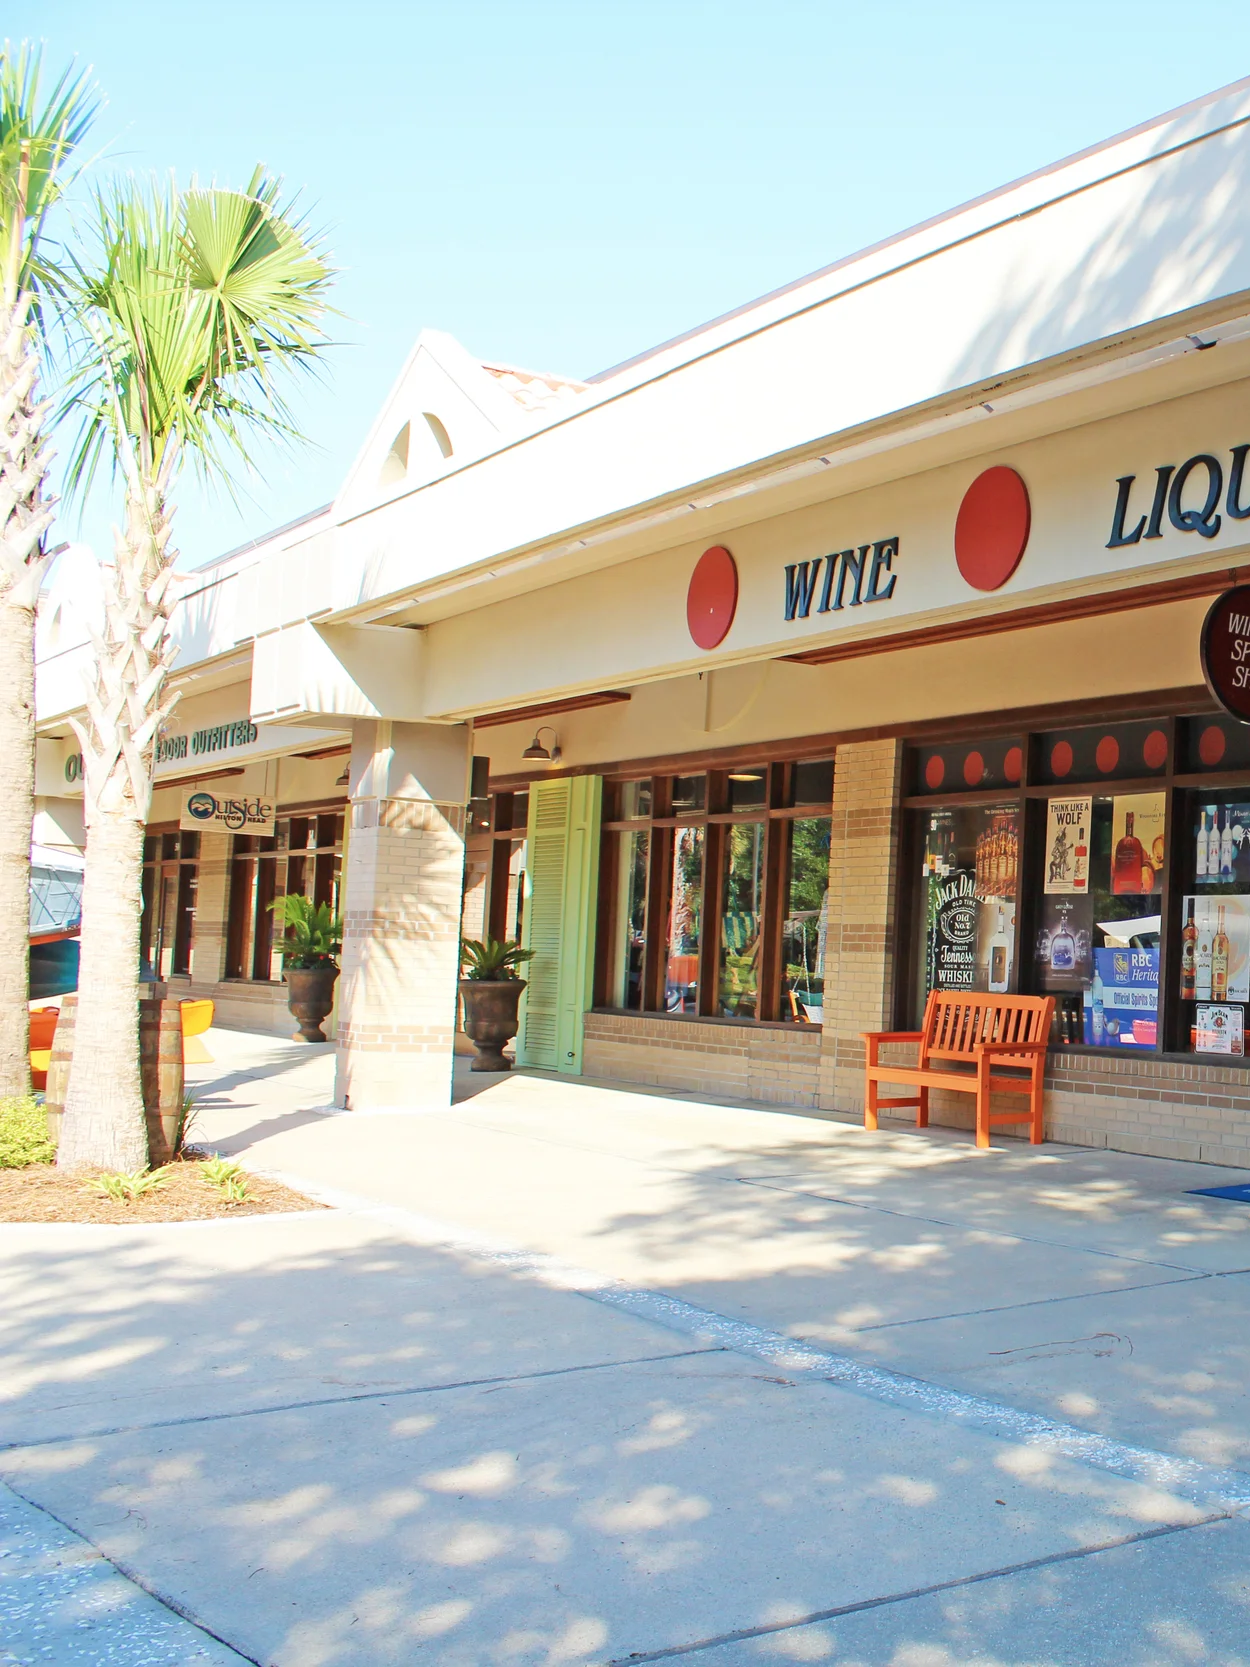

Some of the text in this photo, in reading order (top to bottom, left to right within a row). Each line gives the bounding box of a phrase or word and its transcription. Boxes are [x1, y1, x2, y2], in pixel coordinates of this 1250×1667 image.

[783, 536, 900, 622] WINE
[1050, 802, 1089, 813] THINK LIKE A
[215, 814, 242, 822] HILTON
[1056, 811, 1082, 825] WOLF
[935, 880, 958, 910] JACK
[952, 899, 963, 907] OLD
[956, 913, 969, 922] Old
[941, 945, 974, 963] Tenness
[1131, 953, 1153, 967] RBC
[1115, 974, 1128, 982] RBC
[1113, 991, 1130, 1005] Official
[1131, 992, 1148, 1007] Spirits
